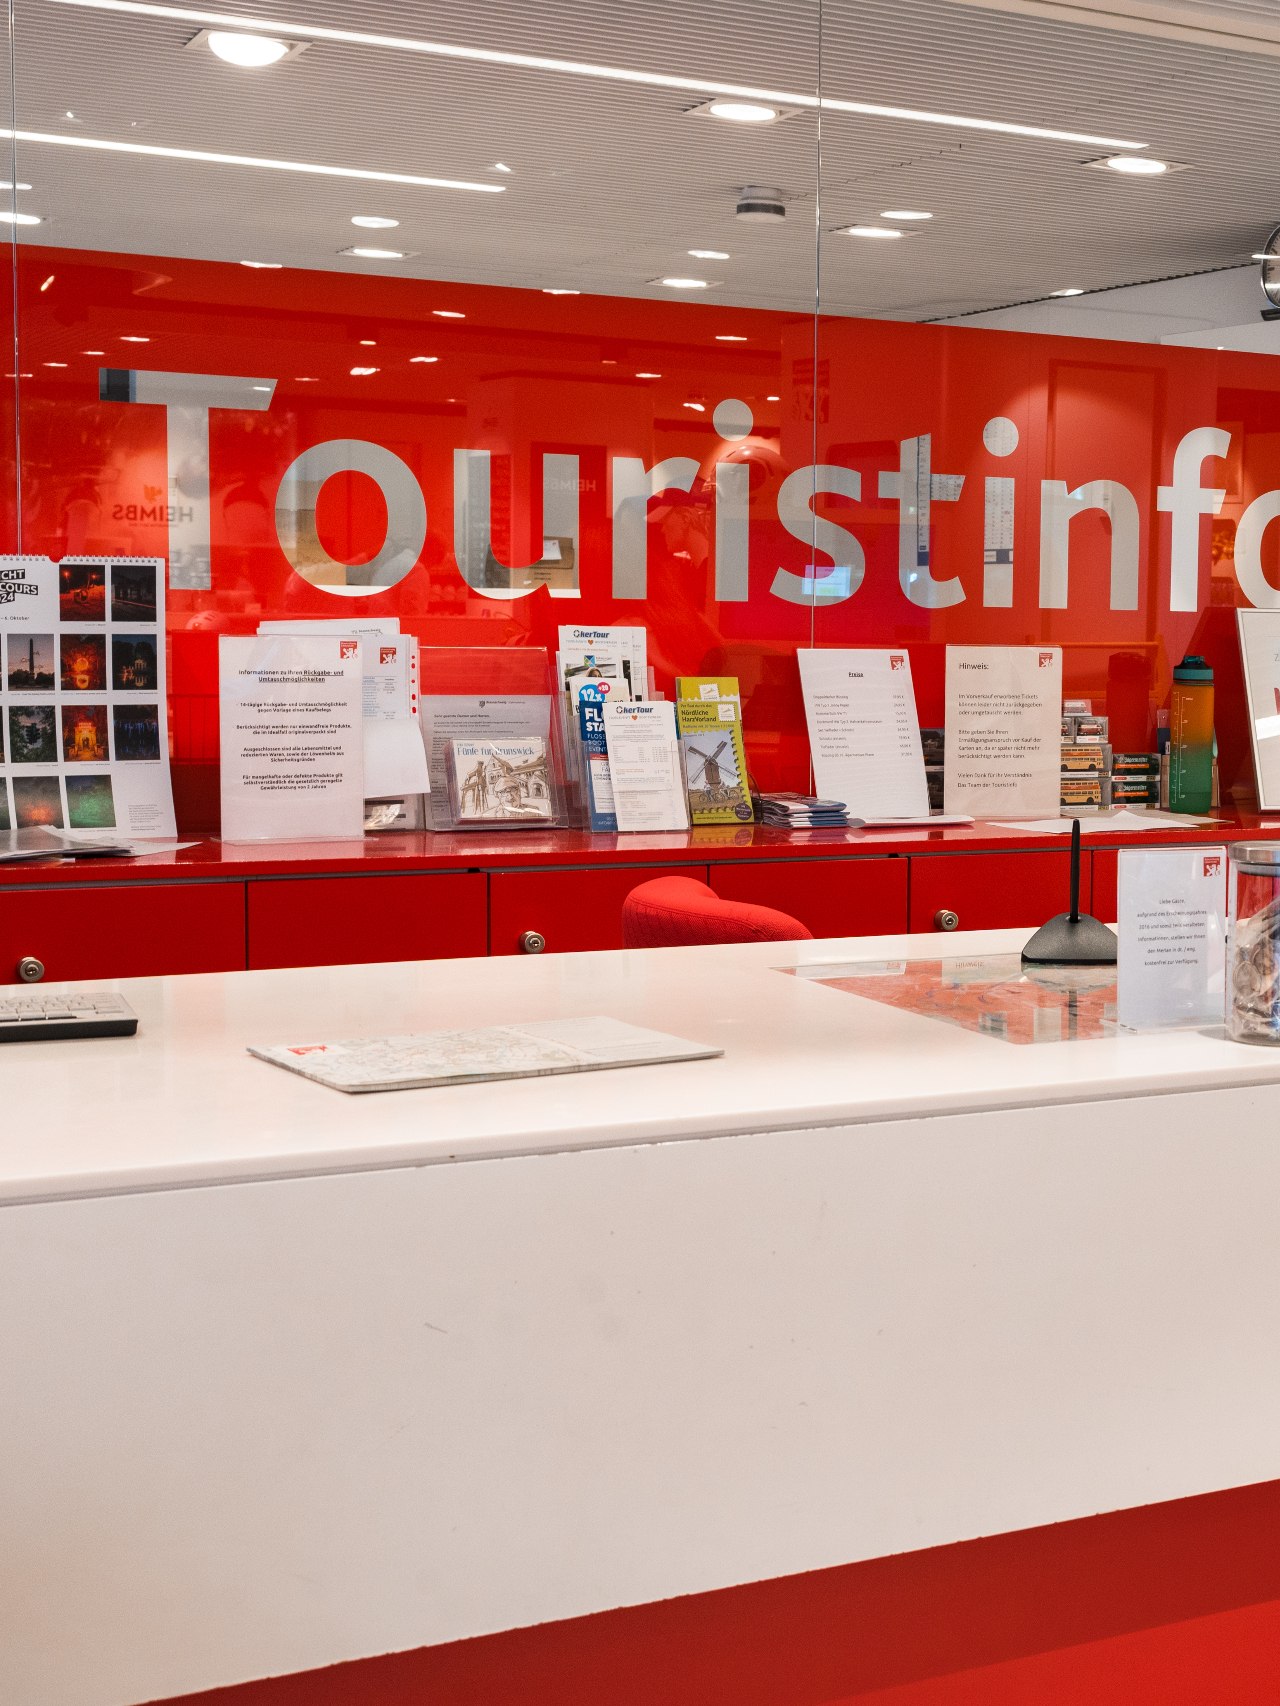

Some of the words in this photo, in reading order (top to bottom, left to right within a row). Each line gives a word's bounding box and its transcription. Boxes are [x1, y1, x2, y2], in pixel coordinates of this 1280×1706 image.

[0, 582, 38, 595] COURS
[0, 593, 14, 603] 24
[585, 708, 604, 721] FL
